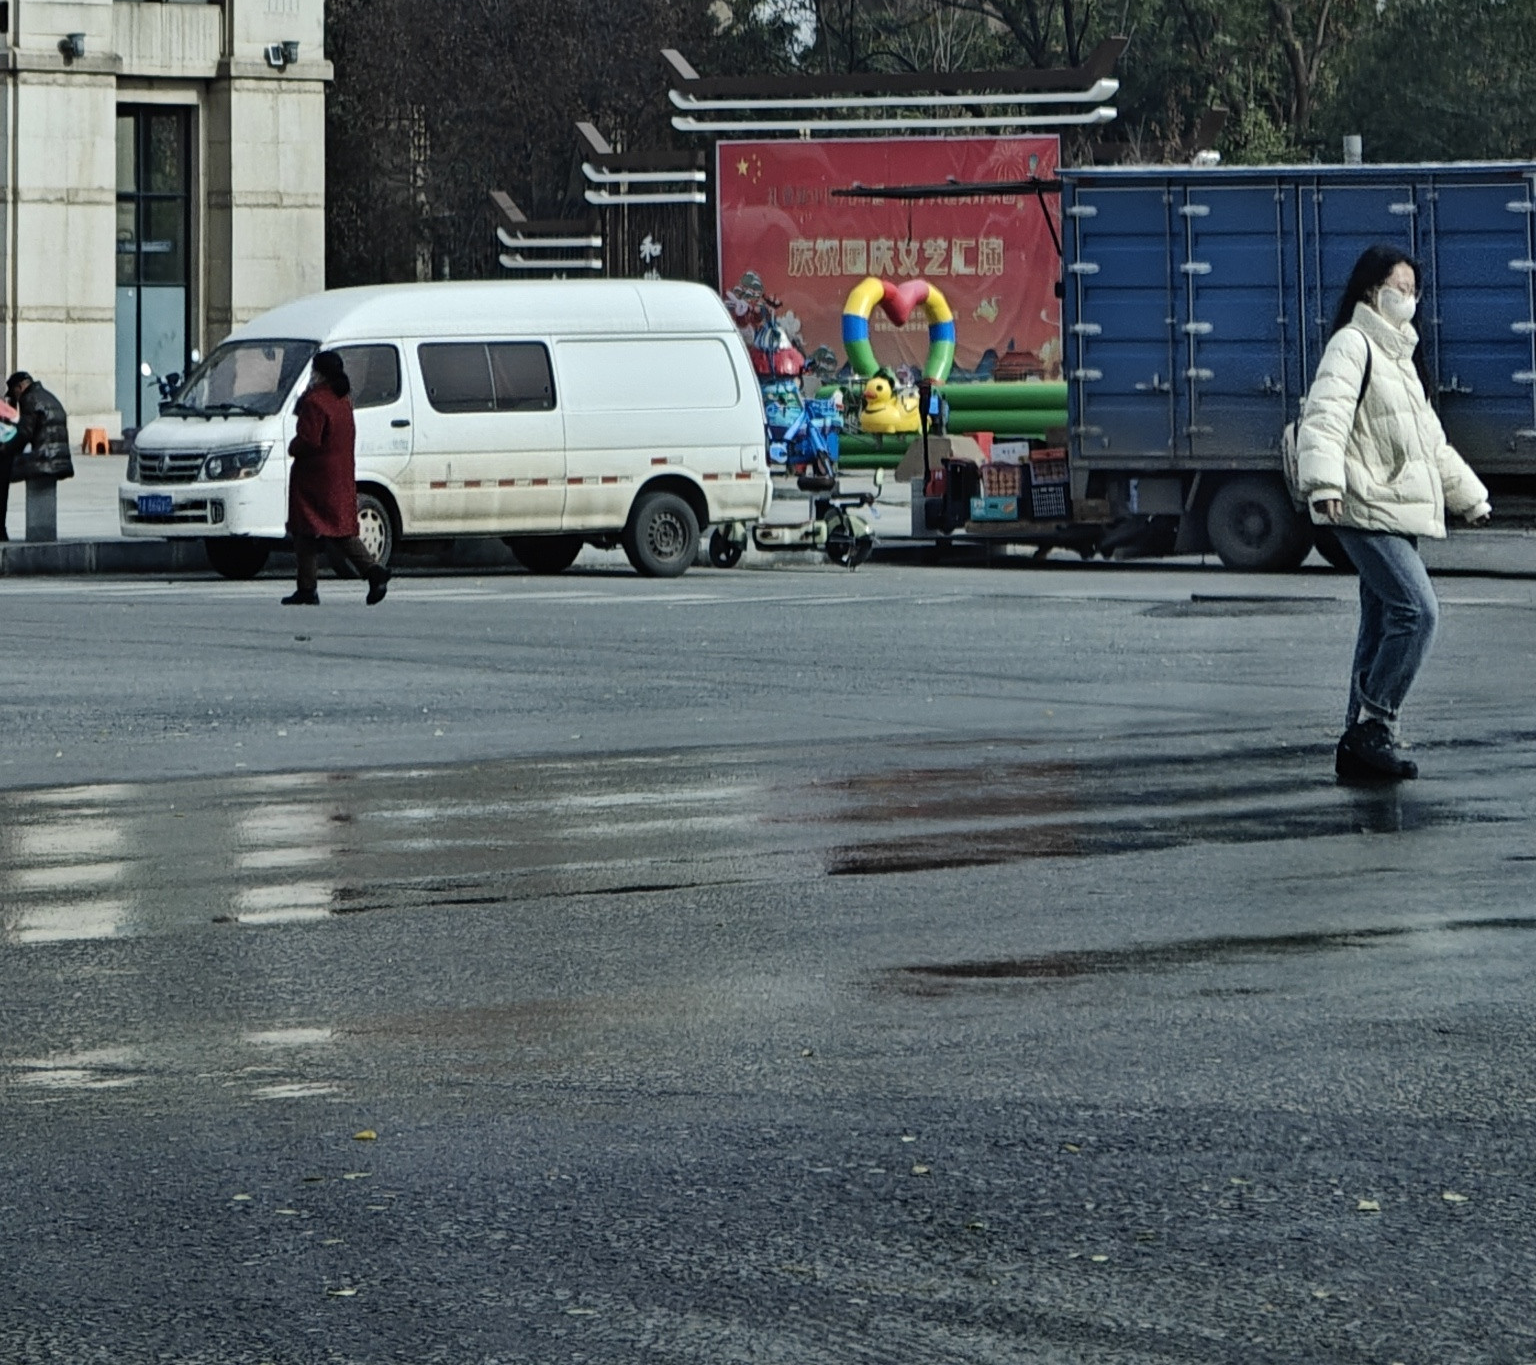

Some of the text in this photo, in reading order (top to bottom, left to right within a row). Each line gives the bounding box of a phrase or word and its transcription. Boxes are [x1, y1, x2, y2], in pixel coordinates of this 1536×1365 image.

[787, 236, 1005, 278] 庆祝国庆文艺汇演
